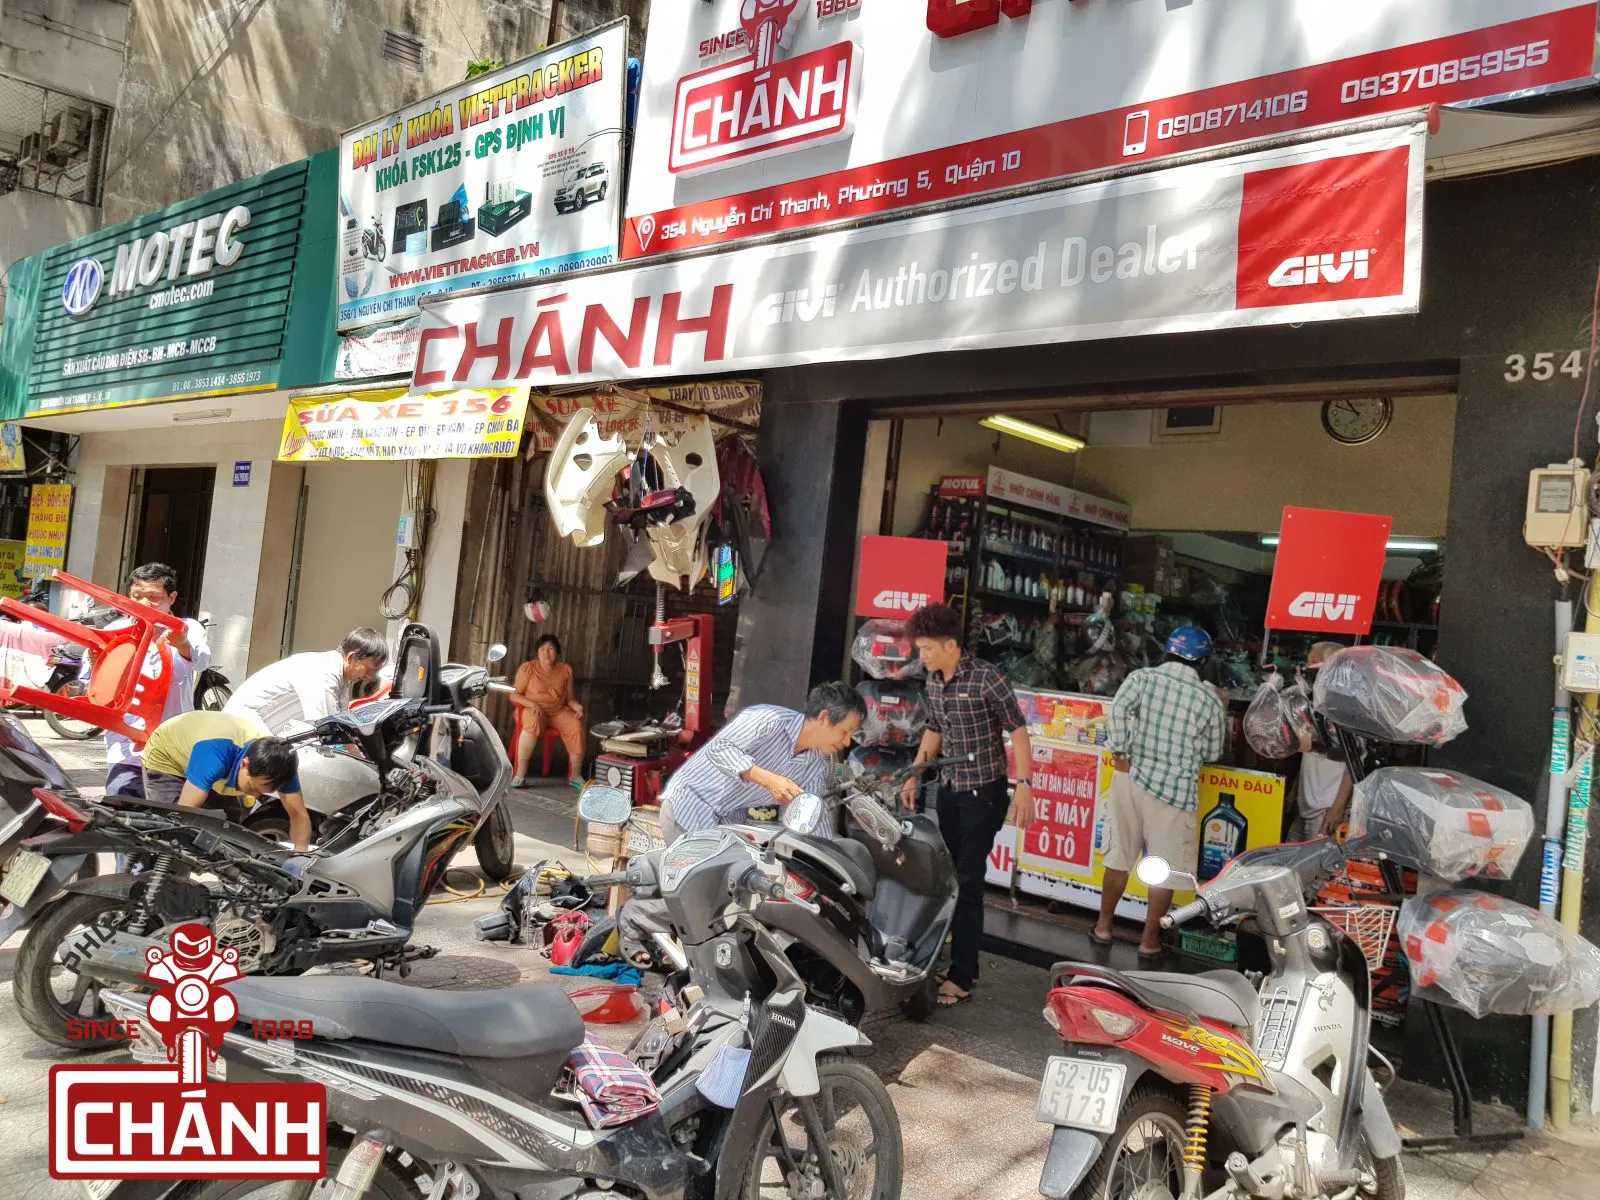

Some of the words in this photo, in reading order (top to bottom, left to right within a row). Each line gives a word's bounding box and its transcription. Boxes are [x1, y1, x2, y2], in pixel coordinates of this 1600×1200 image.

[459, 46, 603, 130] VIETTRACKER
[683, 58, 848, 150] CHÁNH
[1156, 90, 1308, 141] 0908714106
[1340, 39, 1550, 104] 0937085955
[375, 157, 408, 193] KHÓA
[412, 142, 462, 179] FSK125
[474, 128, 502, 160] GPS
[506, 113, 543, 152] ĐỊNH
[549, 106, 566, 139] VỊ
[661, 220, 687, 240] 354
[691, 206, 745, 238] Nguyễn
[750, 200, 773, 220] Chí
[780, 191, 831, 218] Thanh,
[838, 177, 908, 205] Phường
[945, 155, 995, 182] Quận
[1001, 150, 1020, 171] 10
[109, 205, 251, 296] MOTEC
[389, 242, 540, 289] WWW.VIETTRACKER.VN
[1267, 249, 1369, 287] GIVI
[149, 279, 214, 310] cmotec.com
[413, 283, 734, 387] CHÁNH
[850, 241, 1047, 313] Authorized
[1060, 224, 1208, 289] Dealer
[167, 341, 187, 358] MCB
[190, 336, 217, 355] MCCB
[1503, 350, 1583, 383] 354
[297, 404, 359, 426] SỬA
[374, 403, 424, 420] XE
[441, 395, 512, 416] 356
[941, 478, 980, 490] MOTUL
[873, 590, 927, 612] GIVI
[1288, 591, 1356, 621] GIVI
[1033, 797, 1051, 822] XE
[1055, 800, 1090, 828] MÁY
[1038, 826, 1050, 853] Ô
[1054, 831, 1075, 859] TÔ
[771, 1012, 797, 1028] HONDA
[1313, 1023, 1342, 1033] HONDA
[1047, 1090, 1106, 1125] 5173
